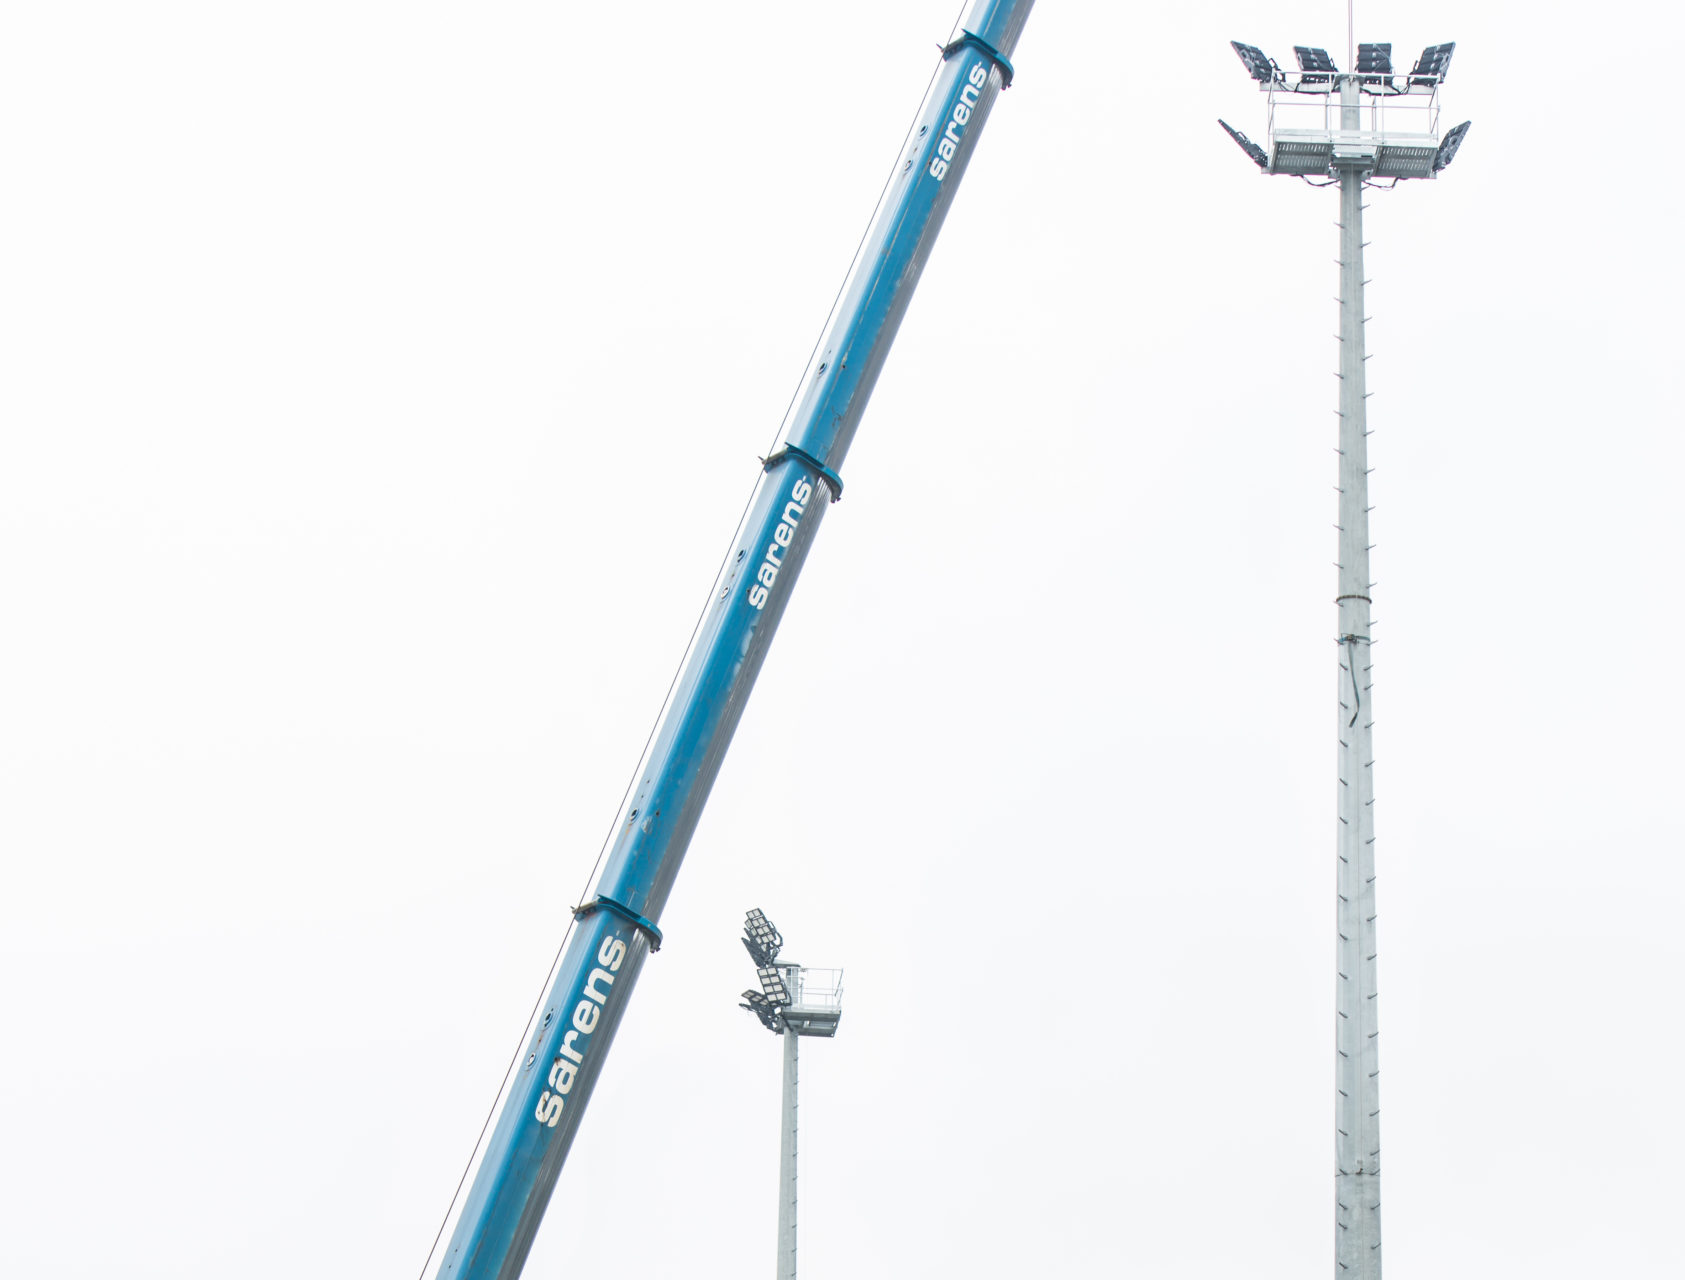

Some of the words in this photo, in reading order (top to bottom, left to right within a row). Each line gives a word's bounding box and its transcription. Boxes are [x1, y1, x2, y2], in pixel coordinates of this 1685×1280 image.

[929, 63, 987, 181] sarens
[748, 478, 813, 610] sarens
[534, 935, 627, 1128] sarens
